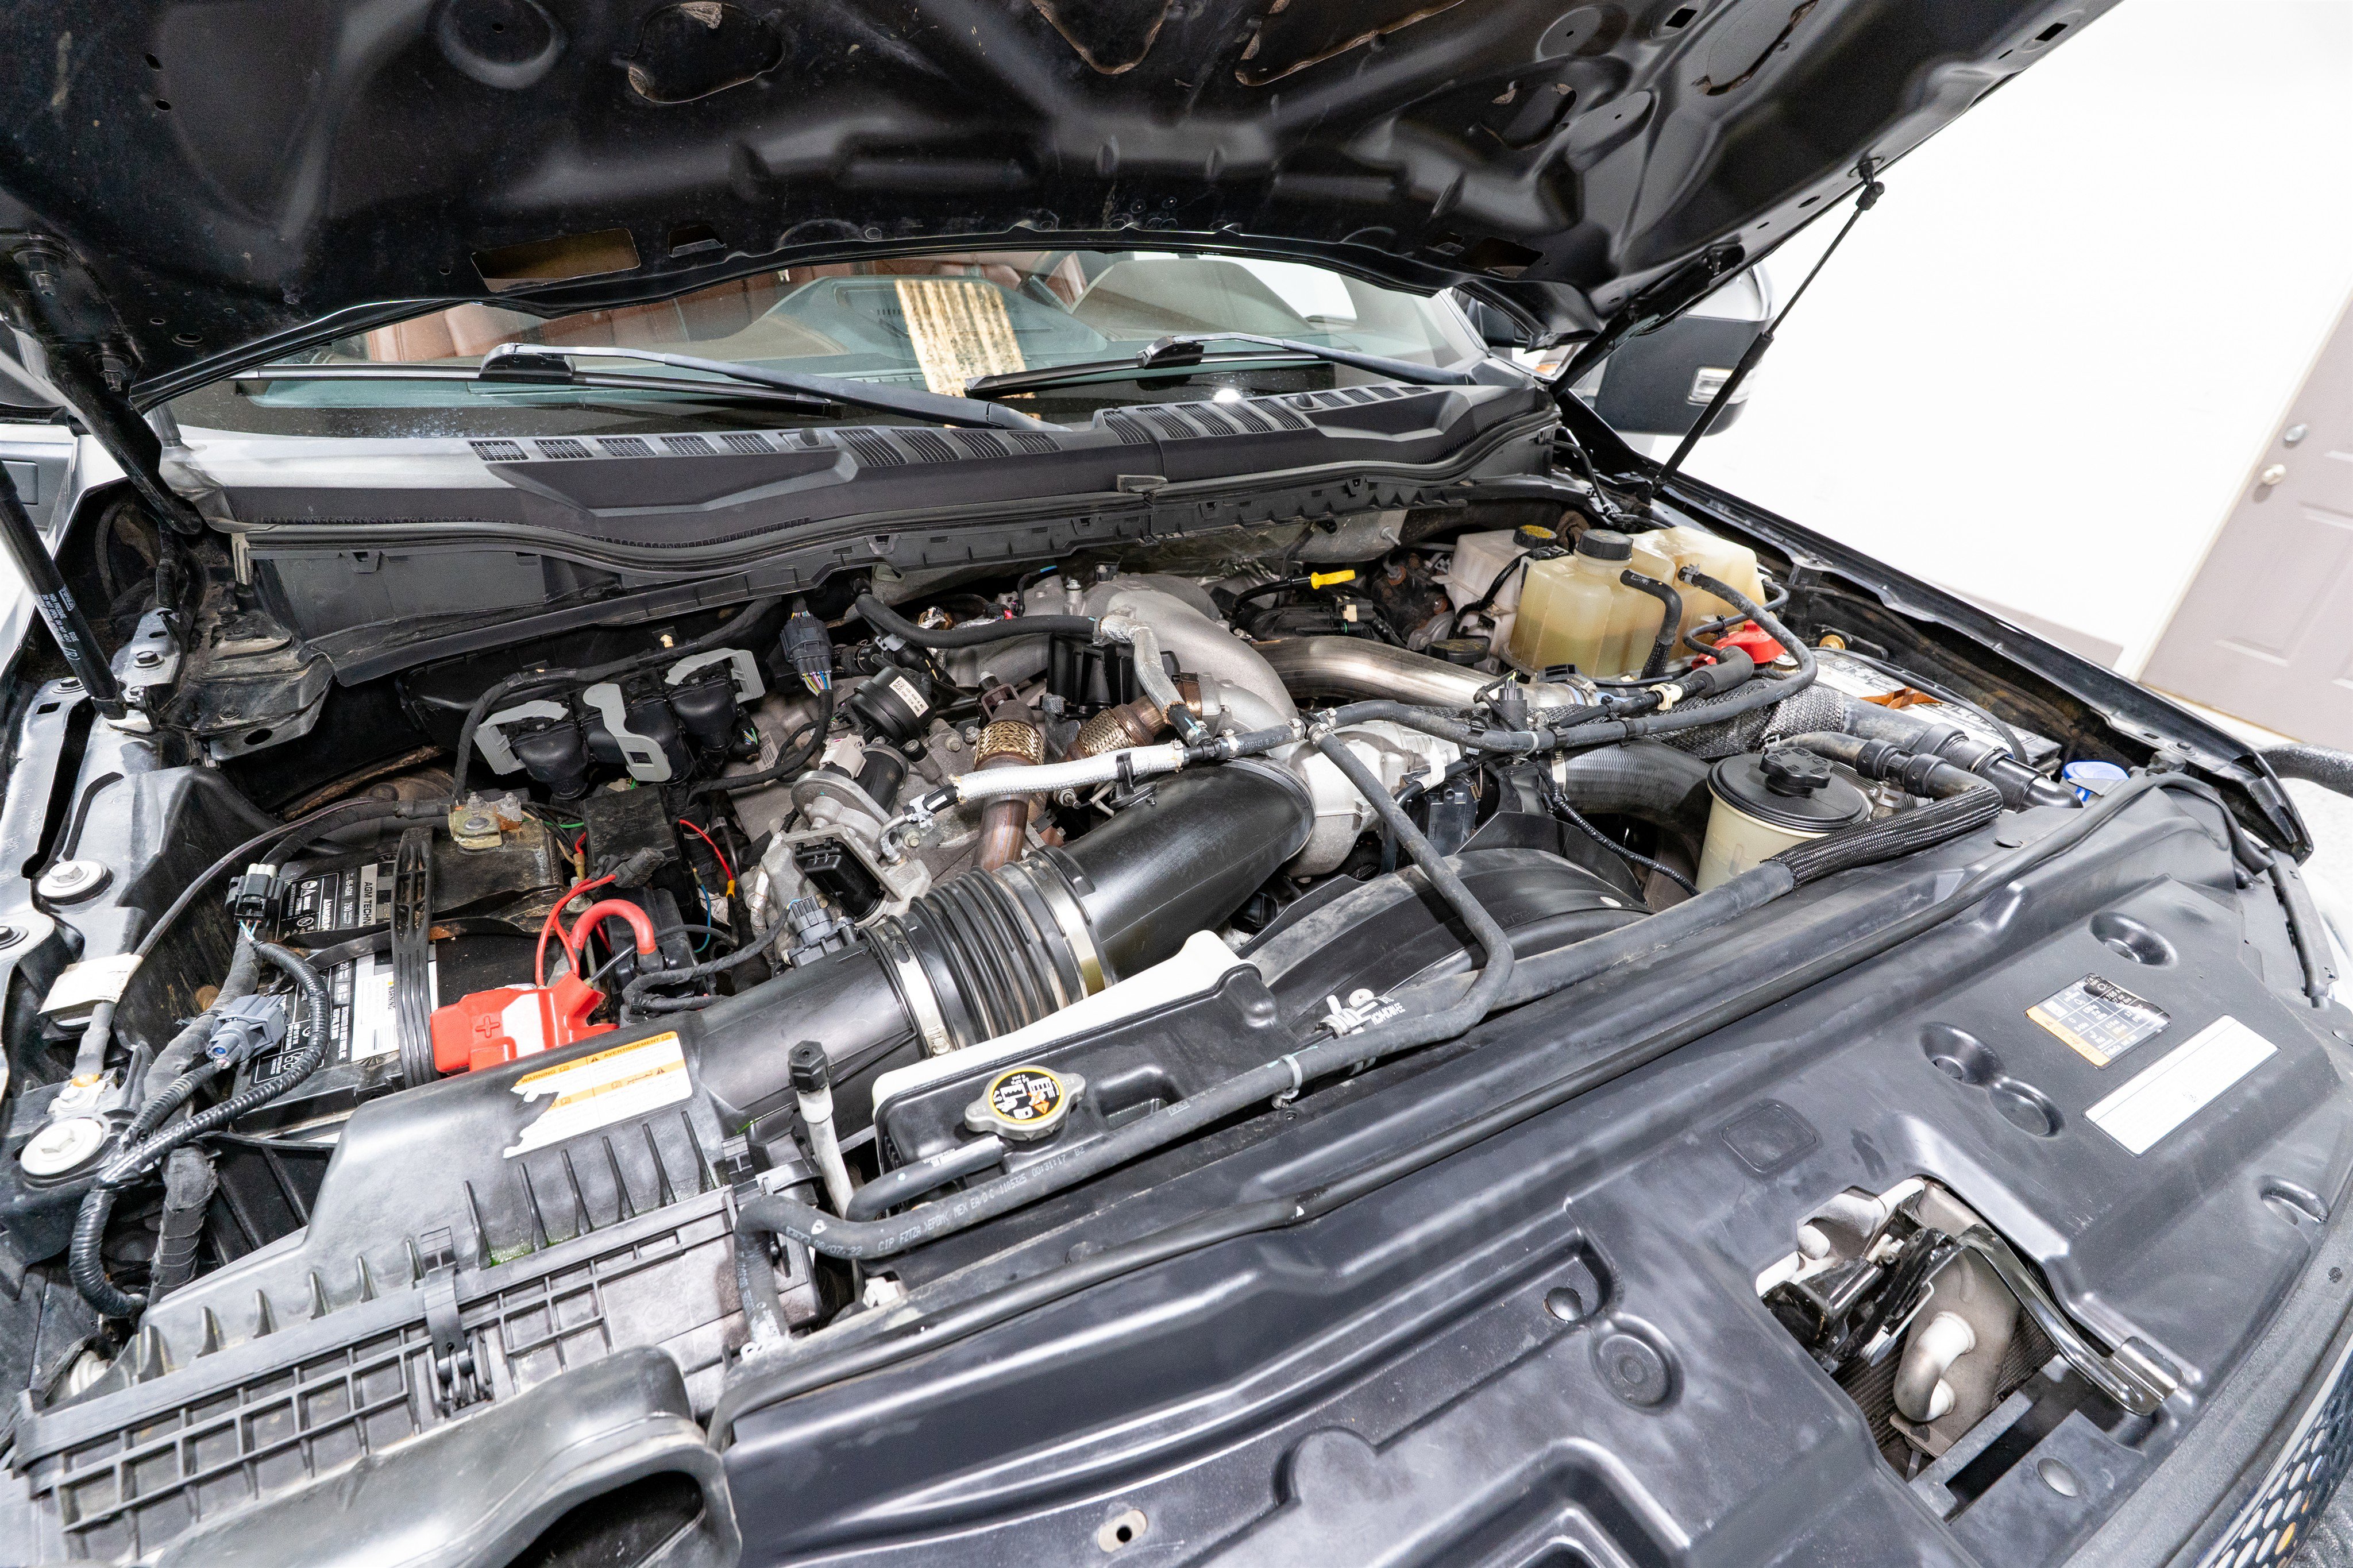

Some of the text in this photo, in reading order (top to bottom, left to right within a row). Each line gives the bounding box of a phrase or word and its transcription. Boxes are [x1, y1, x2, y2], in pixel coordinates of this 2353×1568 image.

[45, 600, 54, 608] NOT
[58, 625, 67, 633] NOT
[52, 602, 67, 619] PRESSURE
[344, 879, 353, 897] 65-AGM
[364, 881, 372, 898] AGM
[343, 901, 352, 912] 750
[604, 1037, 659, 1058] AVERTISSEMENT
[520, 1069, 556, 1083] WARNING
[876, 1236, 896, 1252] CIP
